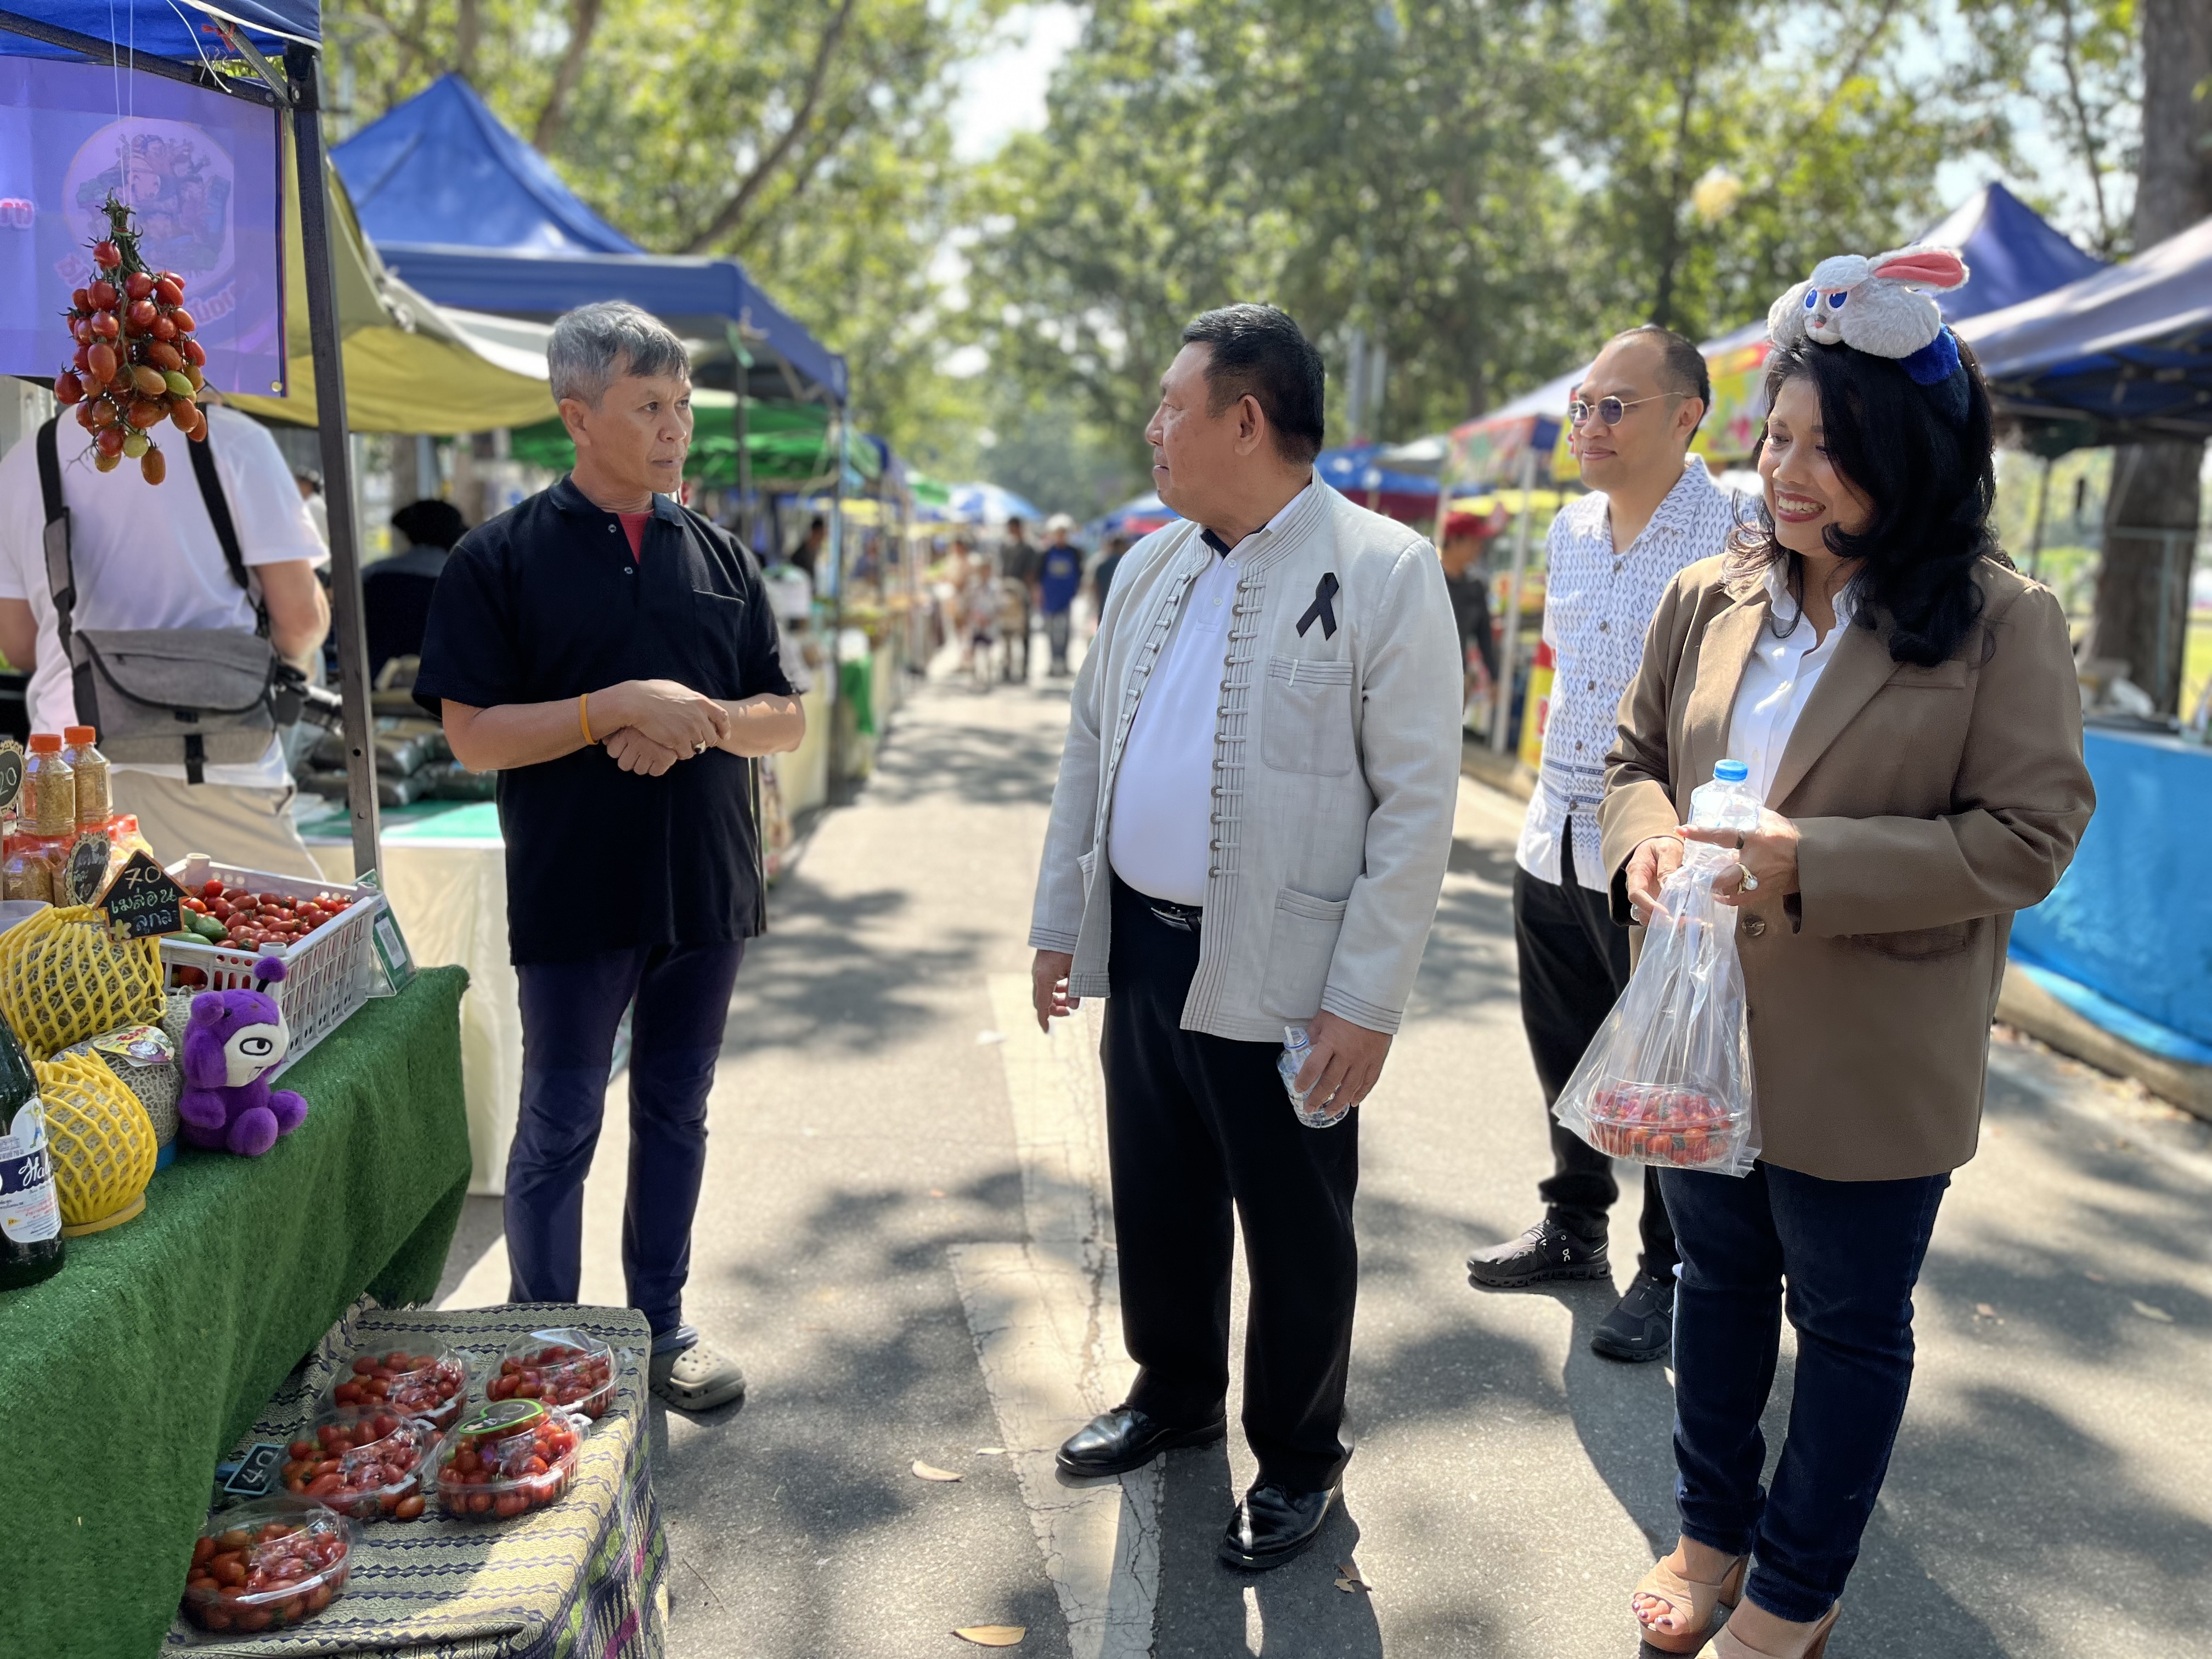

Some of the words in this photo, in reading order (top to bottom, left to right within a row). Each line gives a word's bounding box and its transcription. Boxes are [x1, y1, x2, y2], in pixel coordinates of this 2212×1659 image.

[125, 866, 161, 890] 70
[111, 887, 177, 914] เมล่อน
[241, 1450, 279, 1483] 40
